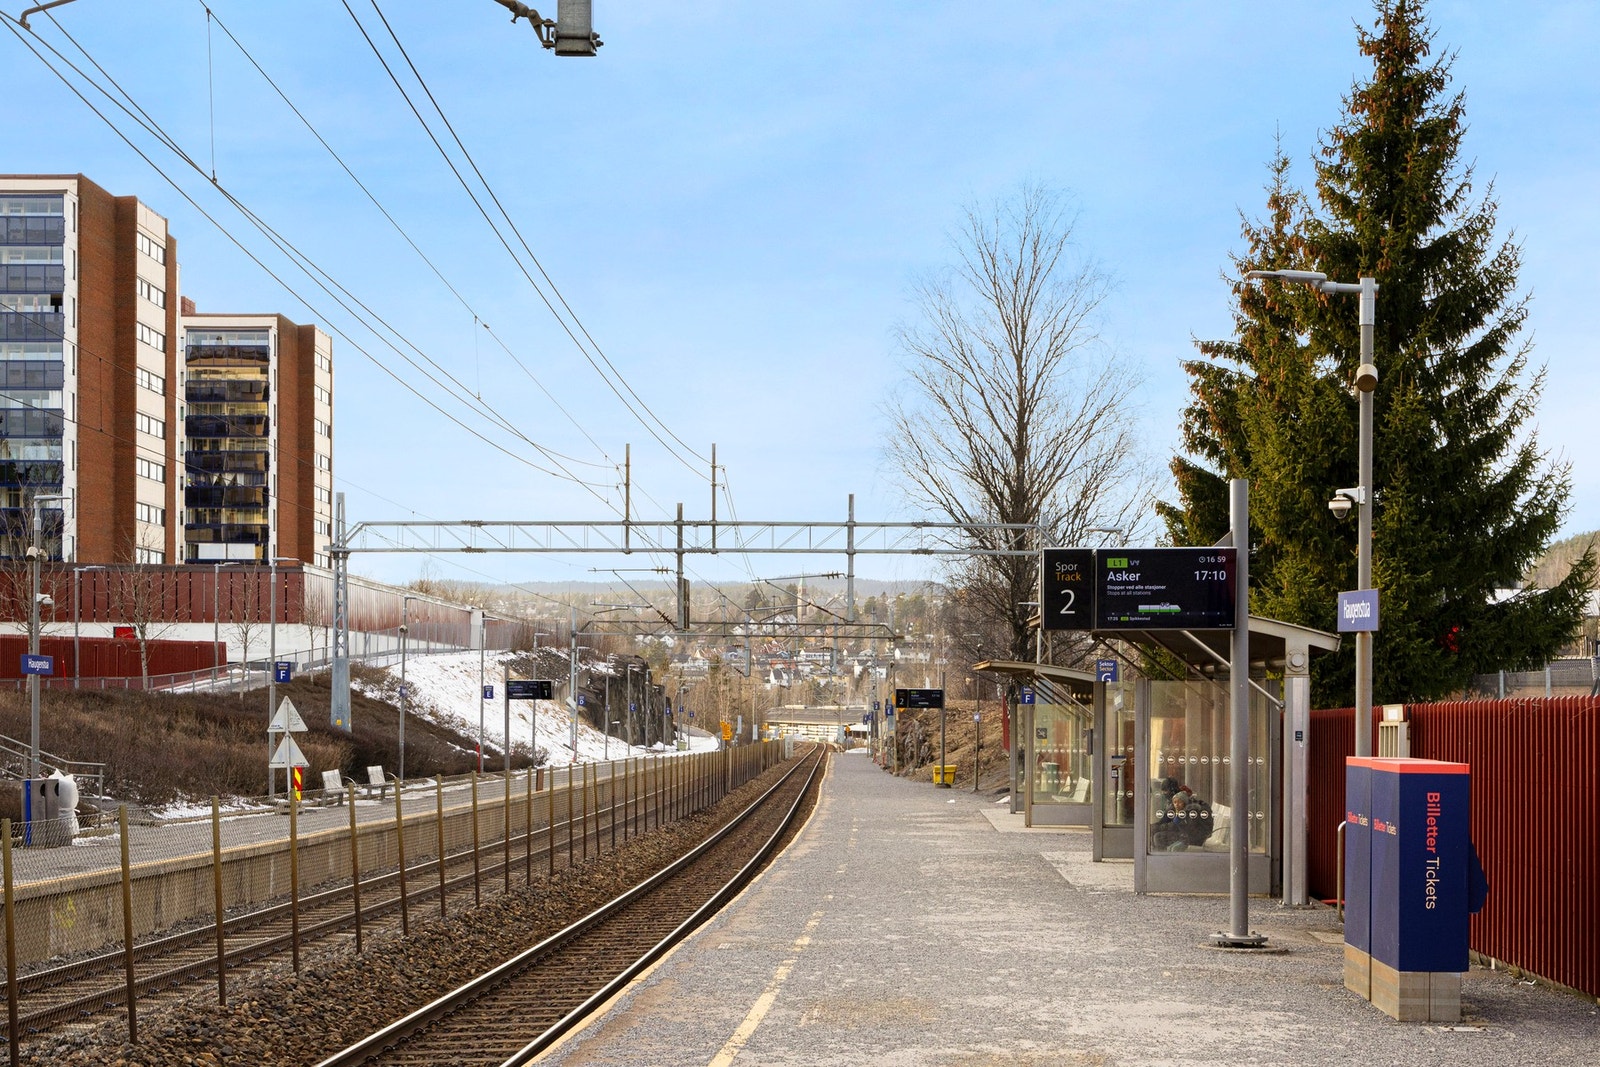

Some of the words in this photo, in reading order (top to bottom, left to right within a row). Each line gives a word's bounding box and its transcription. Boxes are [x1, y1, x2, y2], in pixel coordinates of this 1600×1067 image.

[1055, 561, 1078, 573] Spor
[1055, 572, 1082, 582] Track
[1107, 570, 1141, 582] Asker
[1194, 570, 1227, 581] 17:10
[1060, 589, 1076, 615] 2
[1343, 599, 1371, 624] Haugenstua
[280, 670, 286, 680] F
[1101, 672, 1112, 685] G
[1025, 695, 1031, 704] F
[1426, 792, 1441, 853] Billetter
[1425, 857, 1440, 910] Tickets
